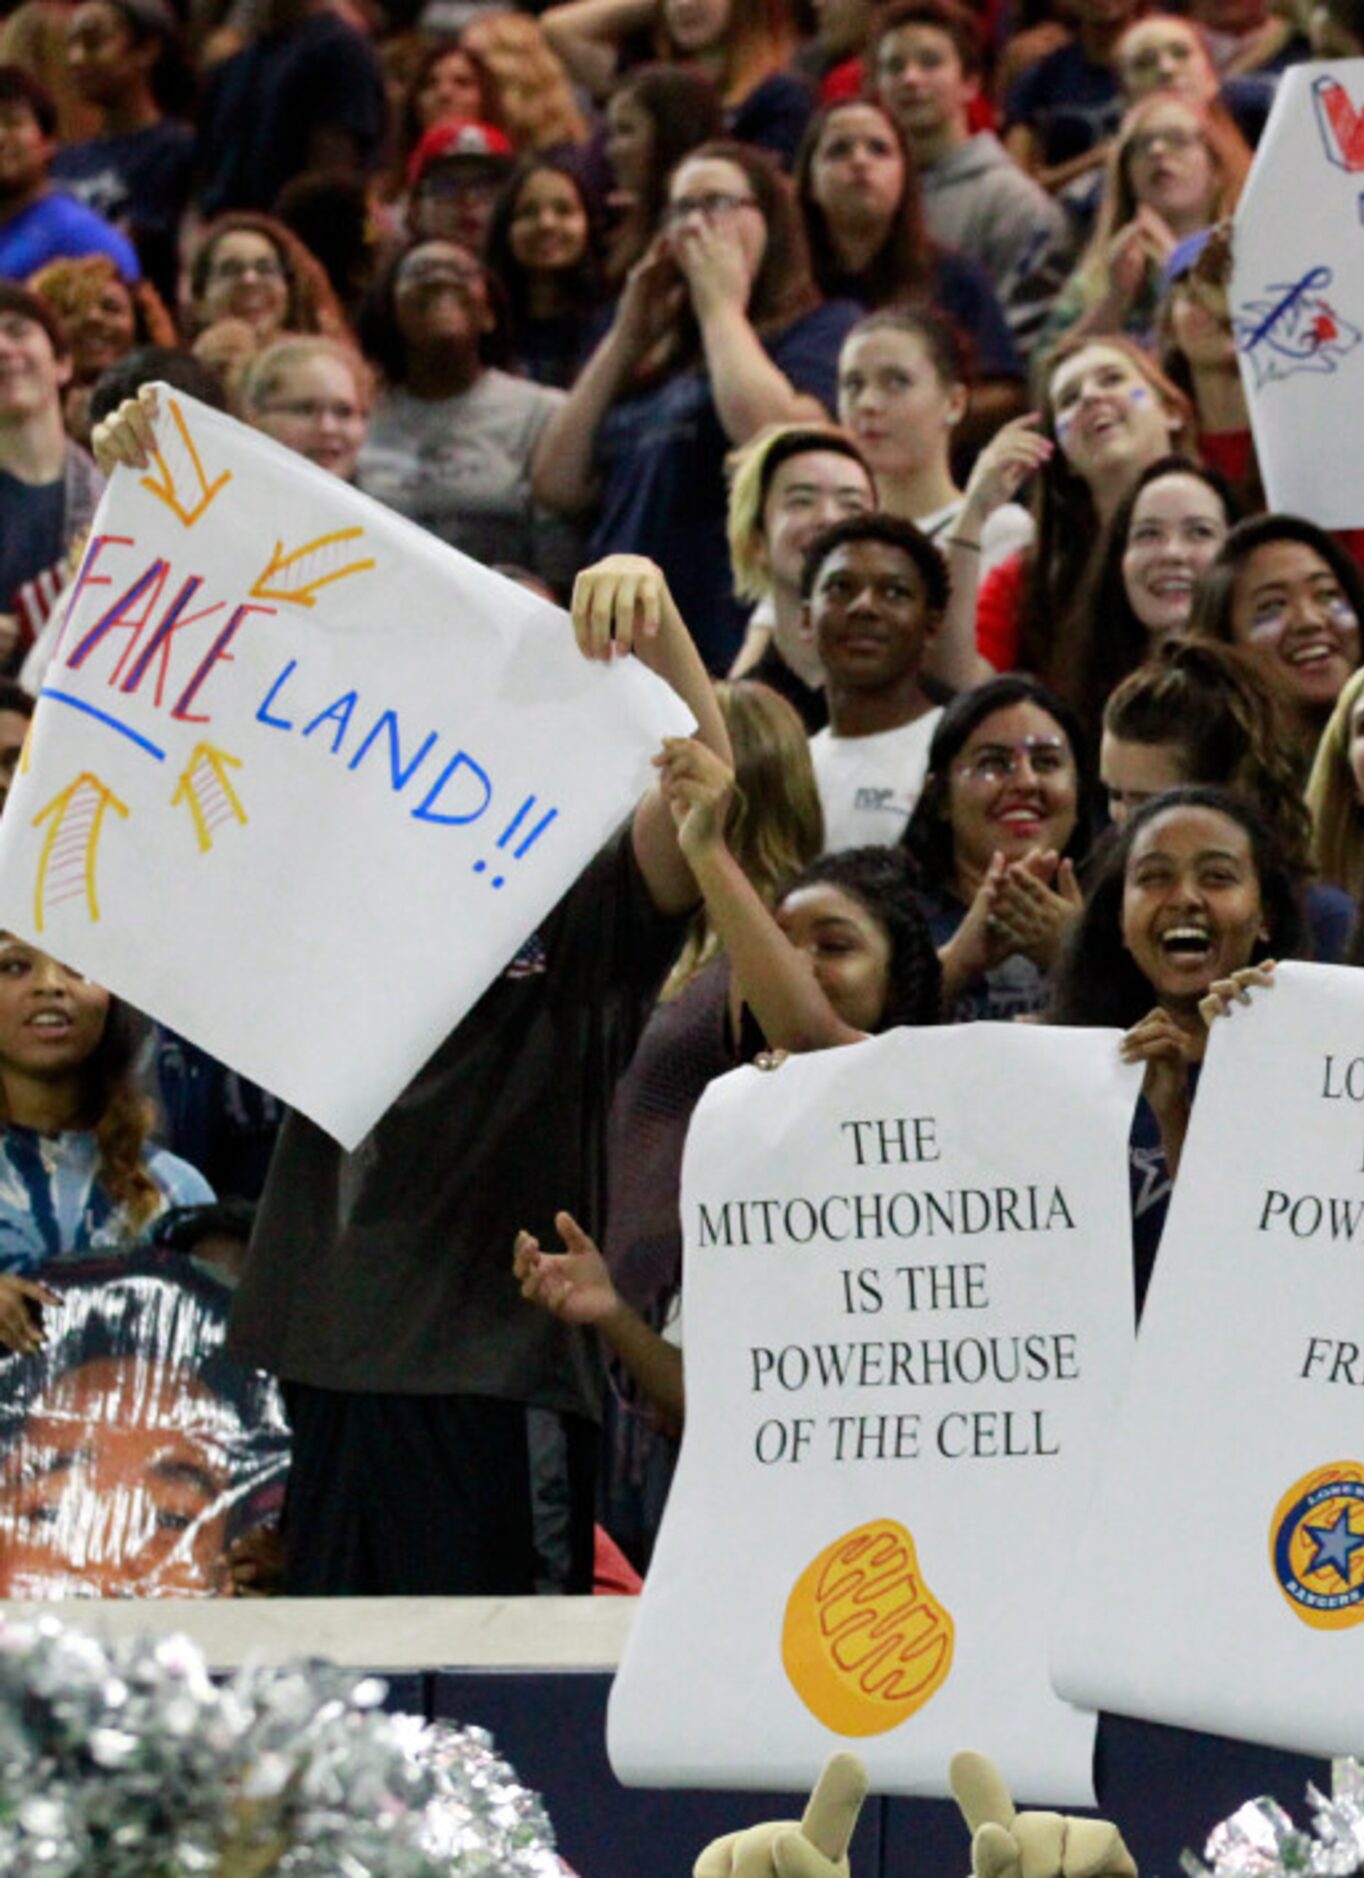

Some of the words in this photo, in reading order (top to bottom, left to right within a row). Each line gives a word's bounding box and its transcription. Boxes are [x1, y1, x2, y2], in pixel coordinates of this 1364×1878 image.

[841, 1117, 941, 1165] THE
[697, 1184, 1076, 1248] MITOCHONDRIA
[840, 1268, 884, 1315] IS
[896, 1263, 990, 1312] THE
[749, 1334, 1080, 1392] POWERHOUSE
[754, 1419, 816, 1465] OF
[828, 1414, 920, 1462] THE
[936, 1410, 1060, 1459] CELL
